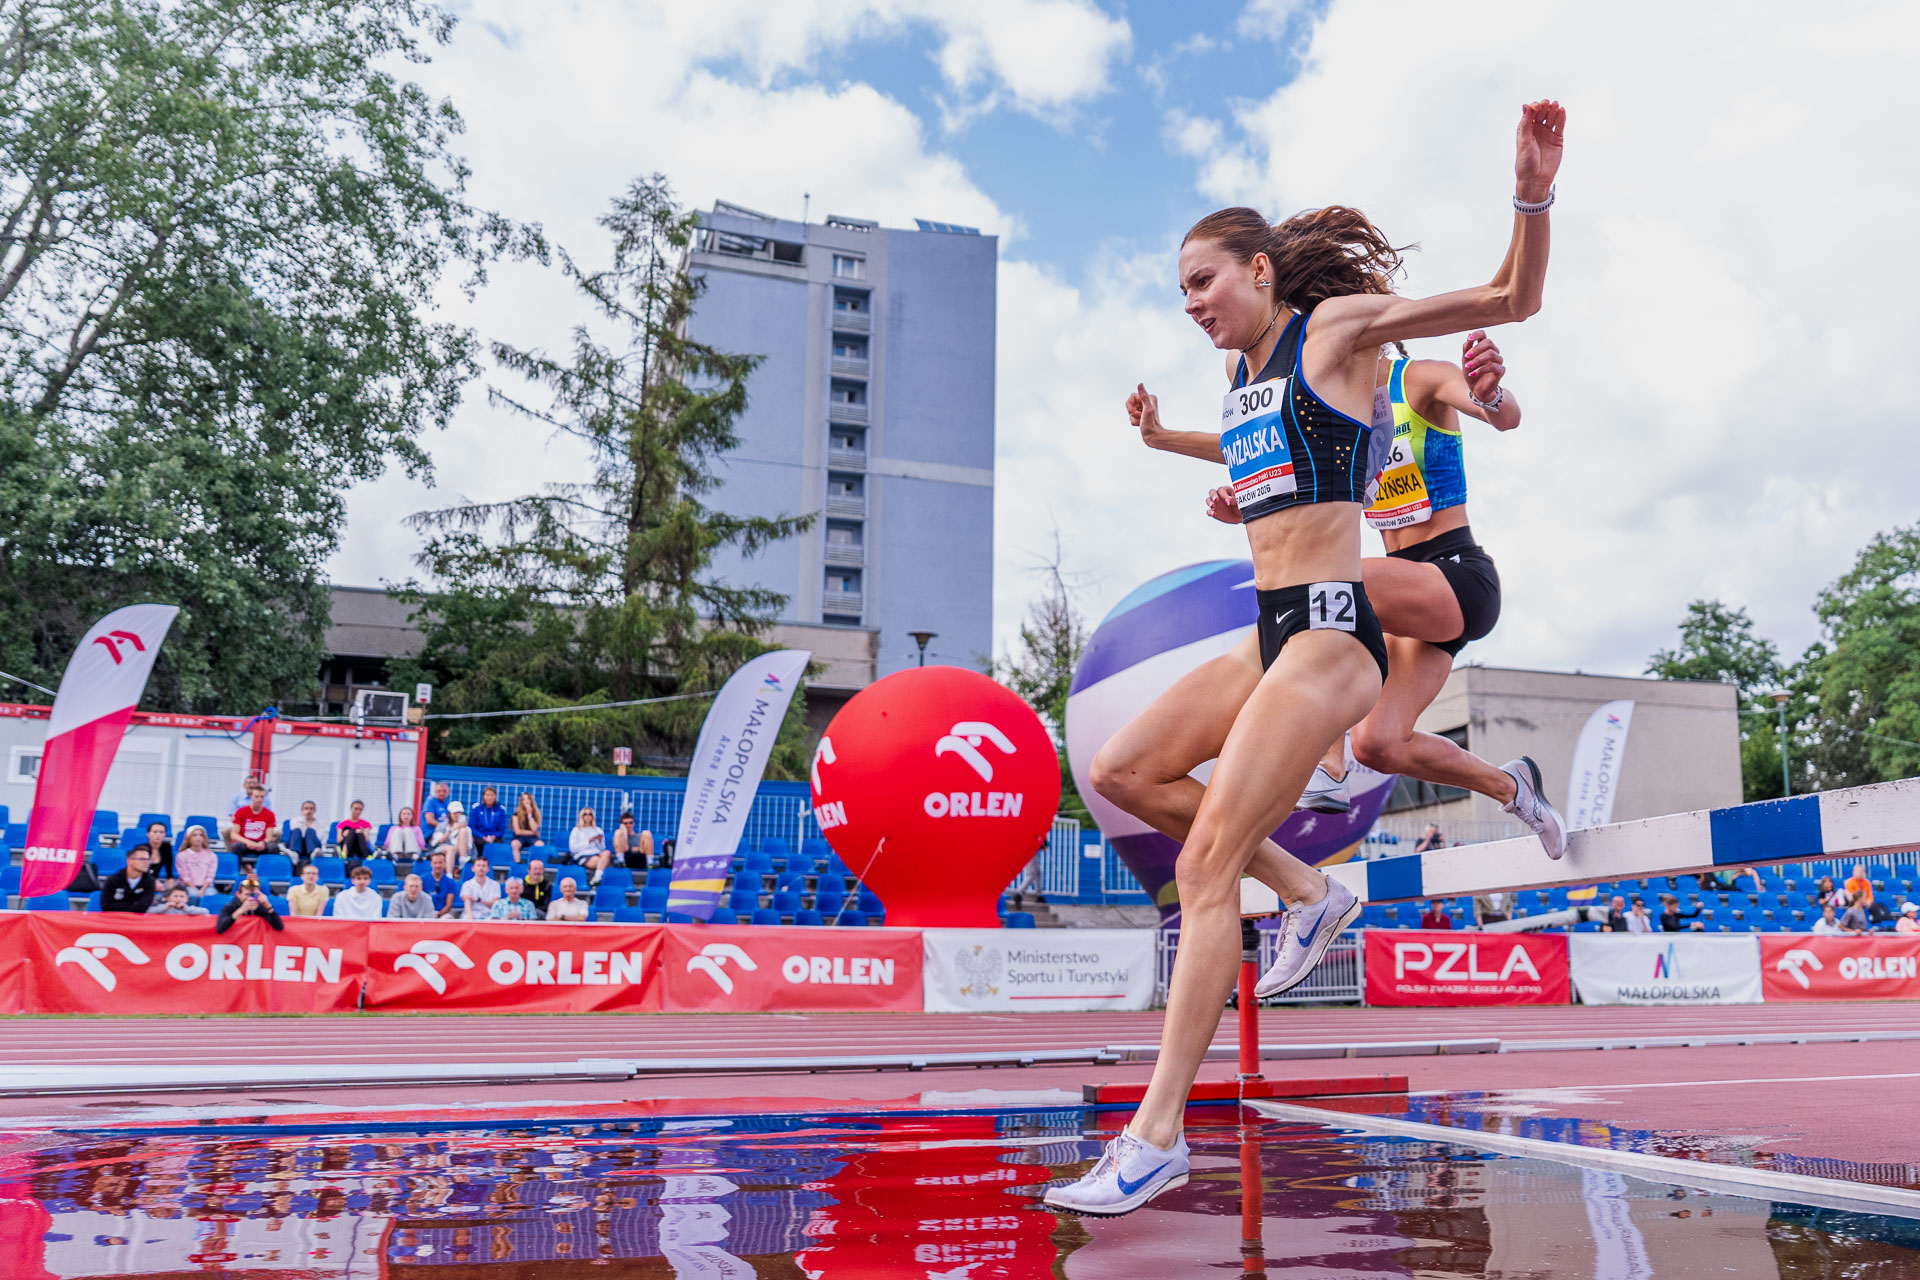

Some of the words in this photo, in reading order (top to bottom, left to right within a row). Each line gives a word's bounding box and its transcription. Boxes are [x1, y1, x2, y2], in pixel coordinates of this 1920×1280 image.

[1239, 387, 1274, 419] 300
[1268, 468, 1282, 478] U23
[1375, 472, 1422, 502] ZYŃSKA
[1396, 515, 1416, 525] 2026
[1312, 590, 1354, 622] 12
[708, 734, 731, 770] Arena
[711, 698, 770, 825] MAŁOPOLSKA
[923, 791, 1024, 818] ORLEN
[25, 846, 77, 864] ORLEN
[165, 942, 343, 983] ORLEN
[487, 949, 643, 985] ORLEN
[782, 955, 894, 985] ORLEN
[1008, 950, 1100, 964] Ministerstwo
[1394, 942, 1541, 981] PZLA
[1839, 956, 1917, 980] ORLEN
[1008, 968, 1055, 985] Sportu
[1059, 969, 1063, 983] i
[1068, 968, 1129, 985] Turystyki
[1617, 985, 1721, 1000] MAŁOPOLSKA
